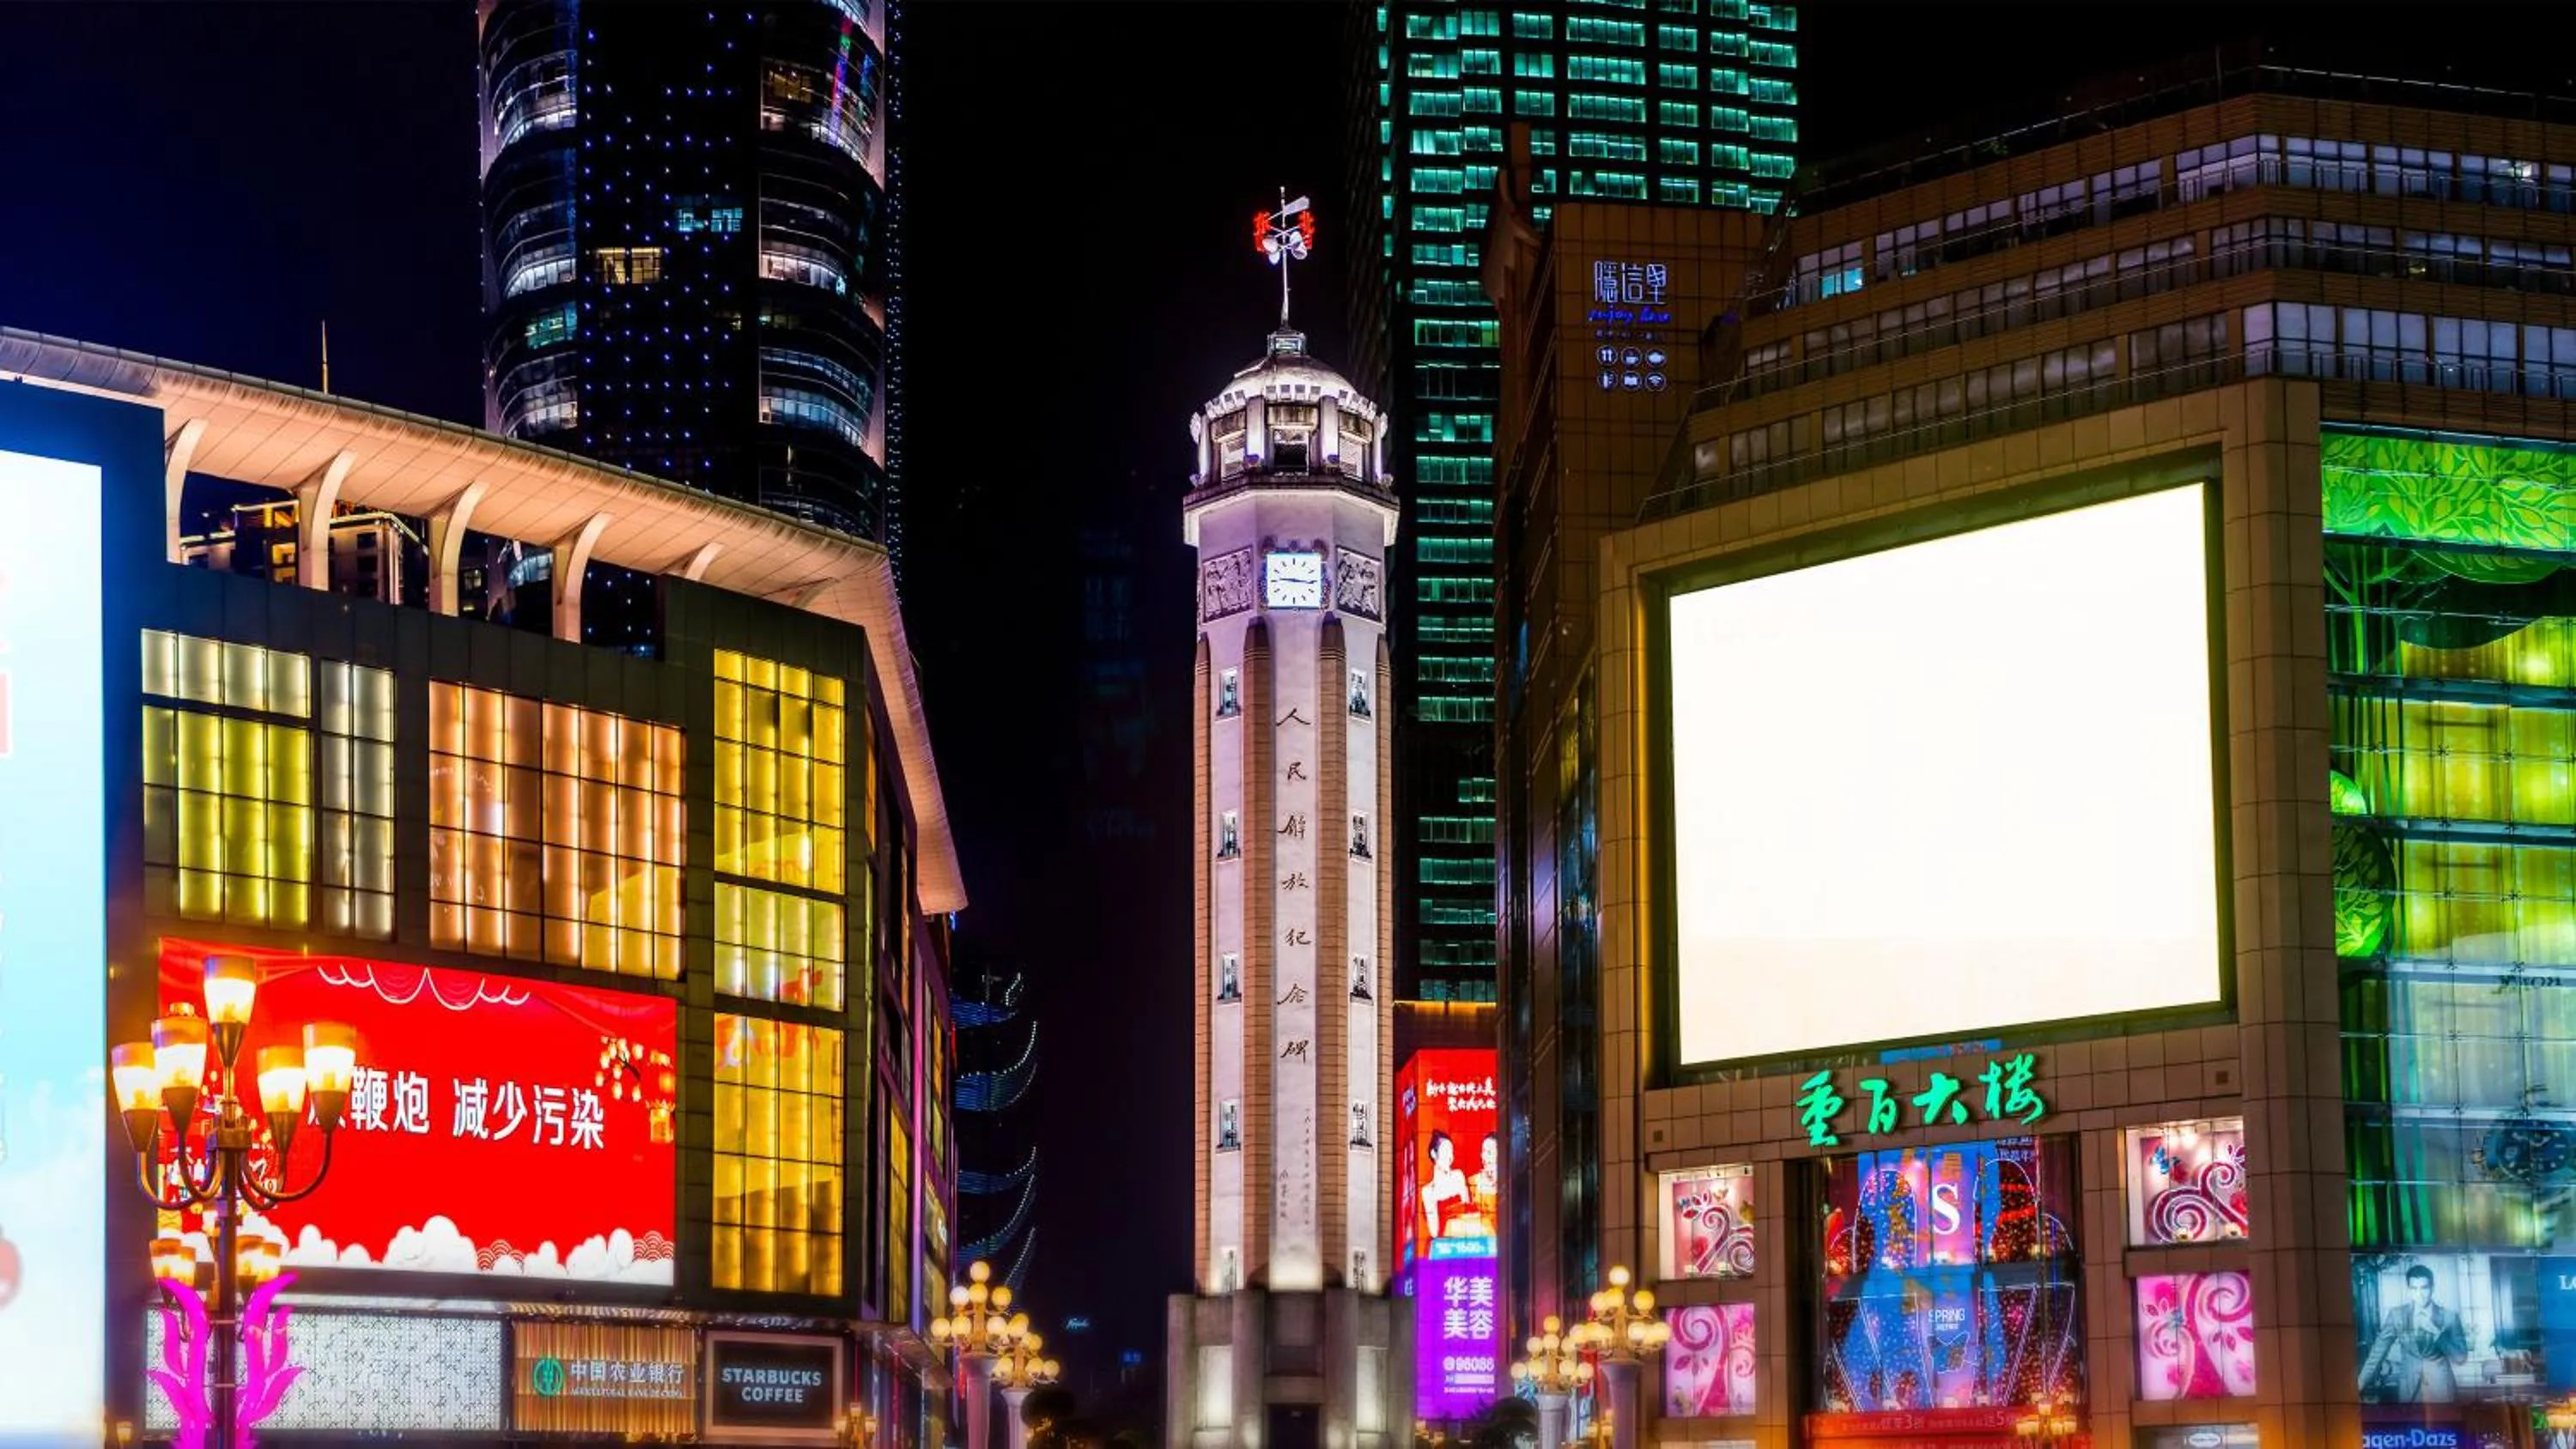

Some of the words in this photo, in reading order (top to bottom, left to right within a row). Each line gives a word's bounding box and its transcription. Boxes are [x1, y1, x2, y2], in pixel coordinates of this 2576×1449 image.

[307, 1065, 429, 1133] 鞭炮
[453, 1077, 604, 1149] 减少污染
[1932, 1183, 1960, 1235] S
[1443, 1276, 1493, 1307] 华美
[1443, 1308, 1493, 1340] 美容
[1928, 1307, 1965, 1323] SPRING
[570, 1360, 683, 1384] 中国农业银行
[721, 1367, 822, 1386] STARBUCKS
[741, 1386, 804, 1403] COFFEE
